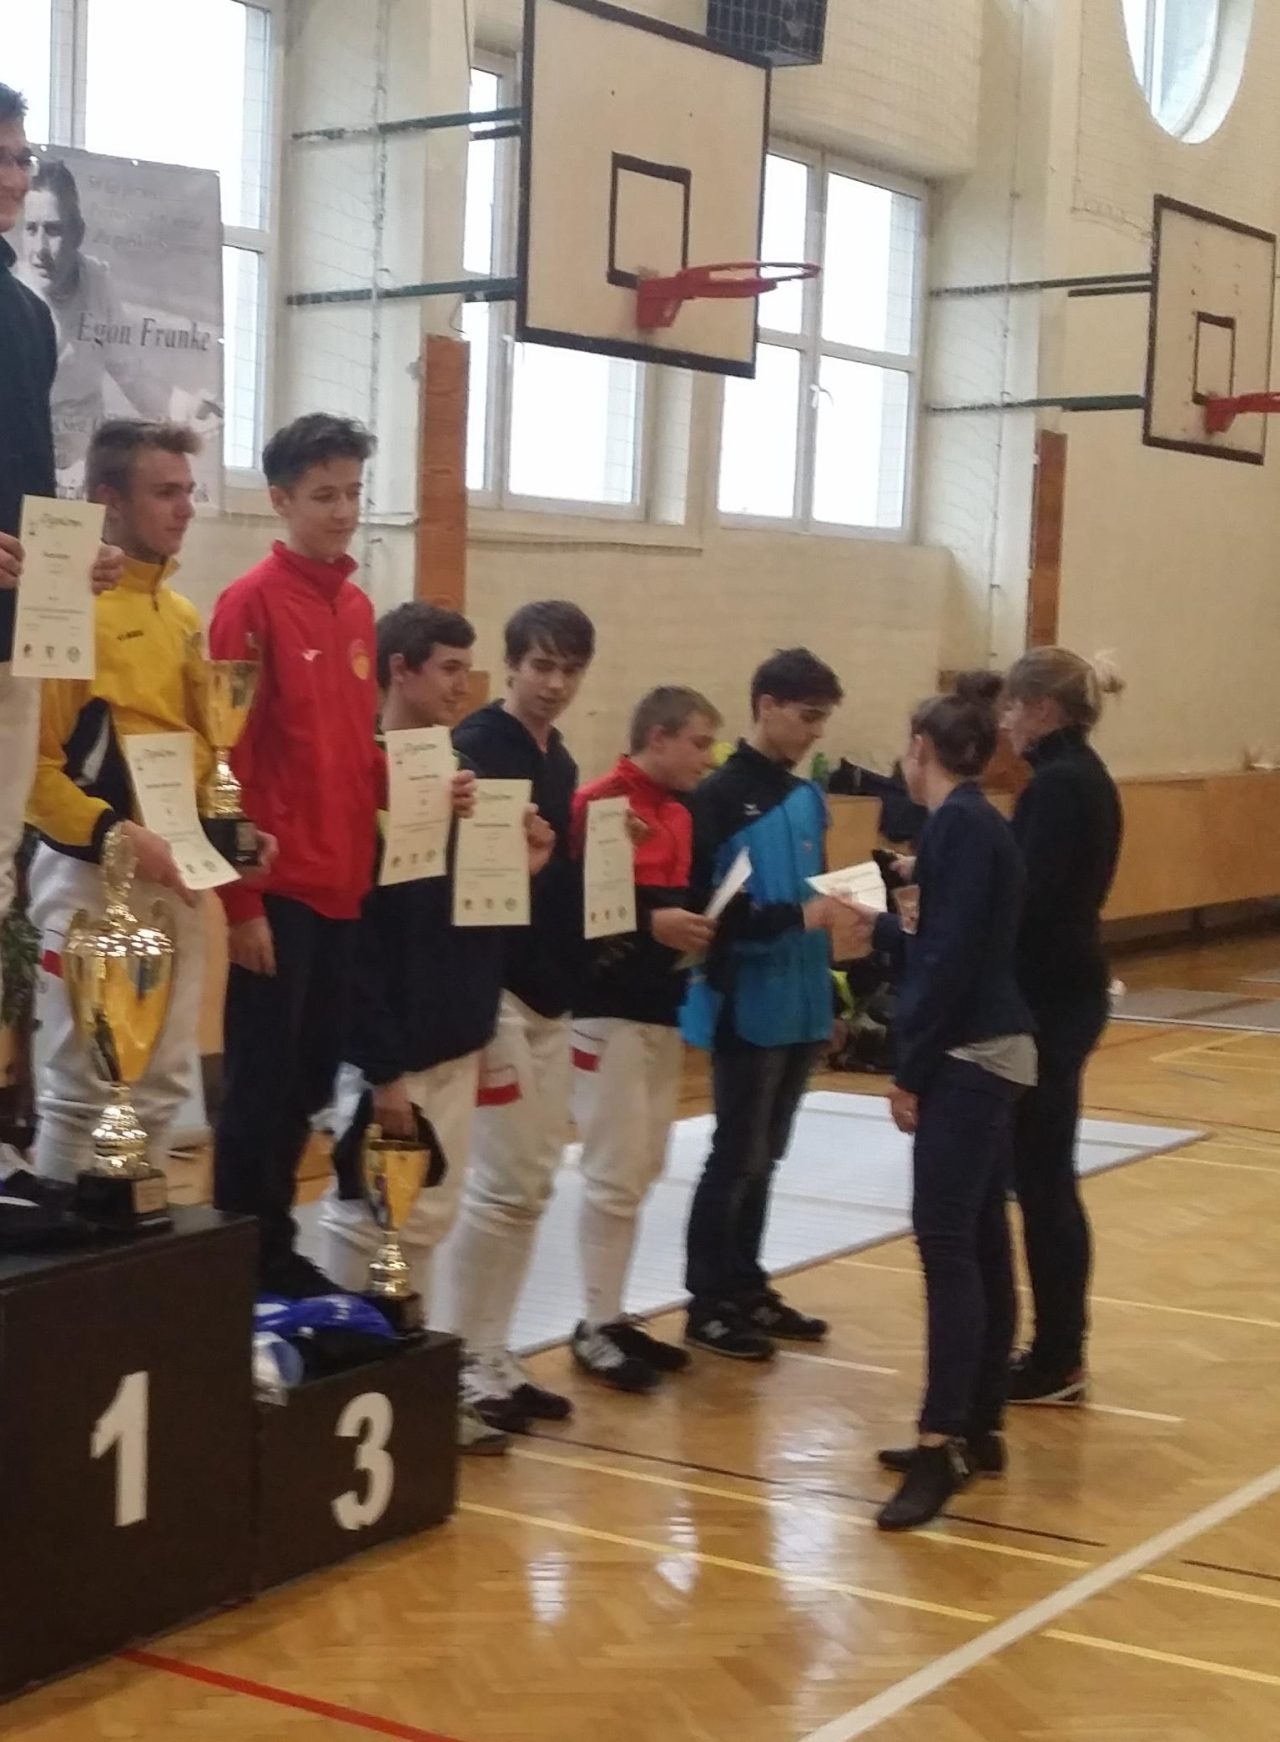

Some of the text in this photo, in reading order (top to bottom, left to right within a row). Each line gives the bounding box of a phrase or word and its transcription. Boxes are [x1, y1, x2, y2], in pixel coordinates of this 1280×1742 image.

[76, 312, 211, 351] Egon Franke
[89, 1370, 150, 1528] 1
[330, 1391, 395, 1531] 3
